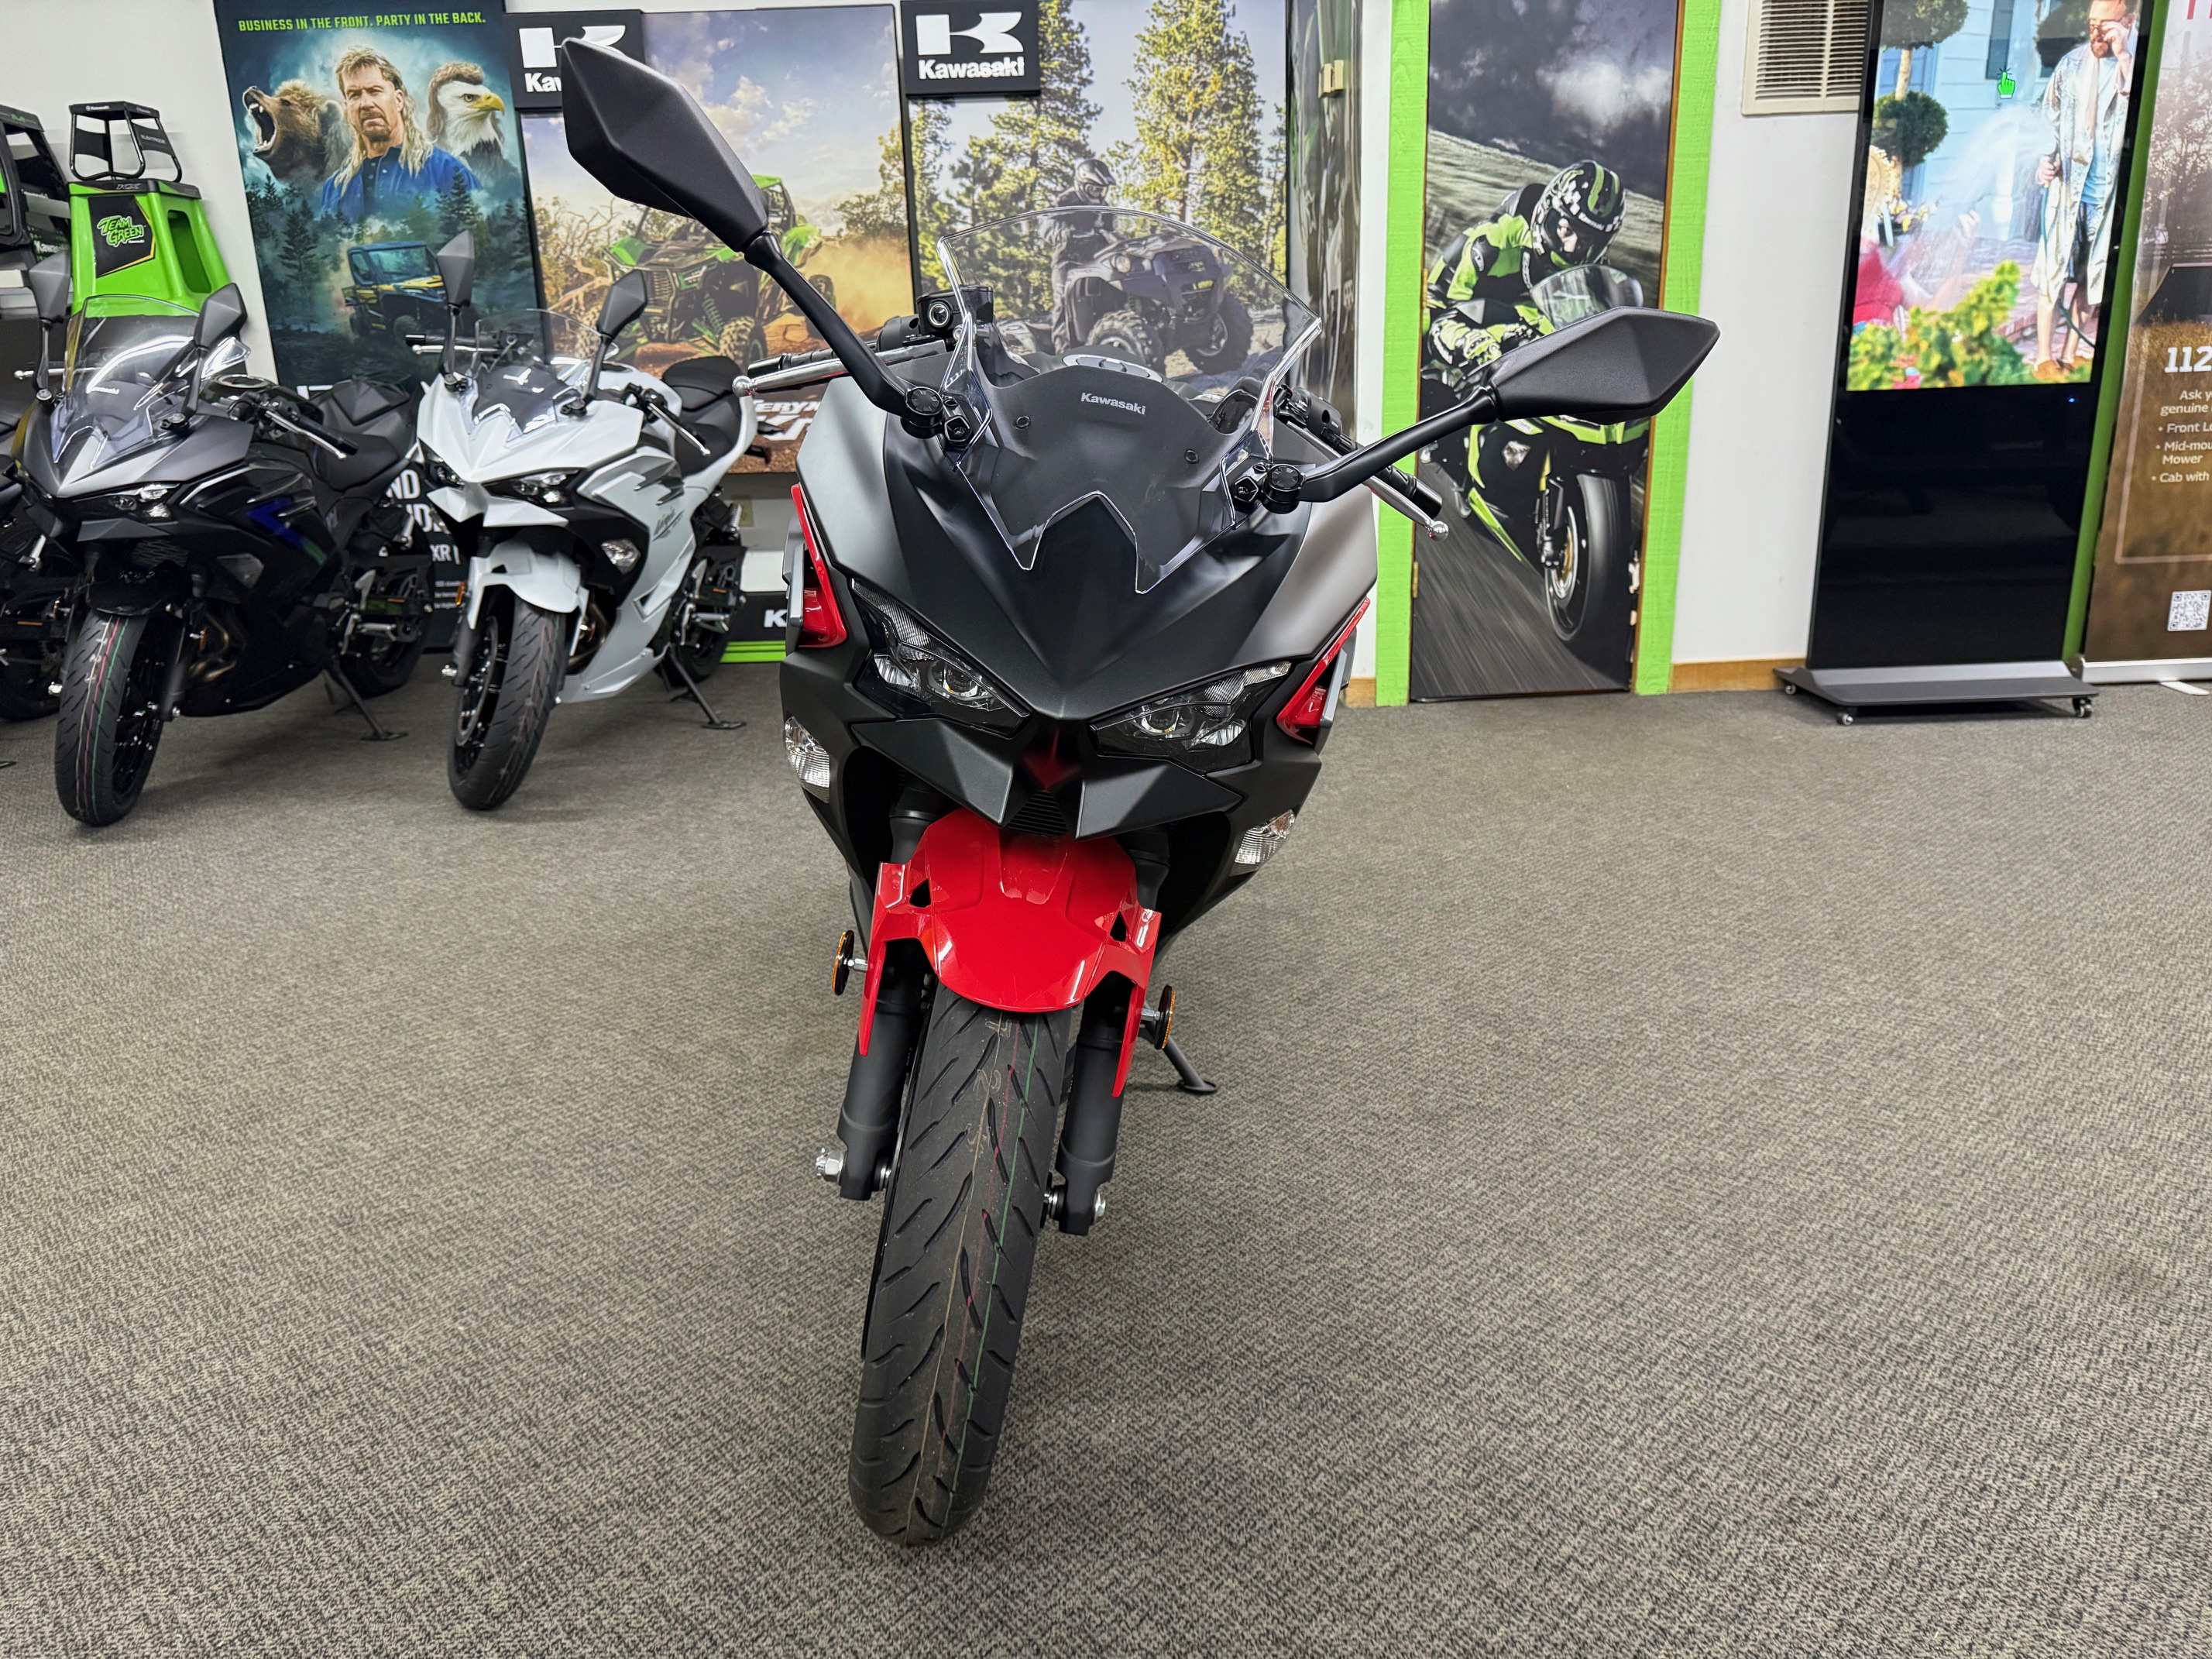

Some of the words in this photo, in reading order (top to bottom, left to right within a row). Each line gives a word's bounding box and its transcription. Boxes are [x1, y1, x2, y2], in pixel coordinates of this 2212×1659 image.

[239, 19, 294, 32] BUSINESS
[295, 18, 308, 30] IN
[310, 17, 332, 29] THE
[334, 15, 373, 28] FRONT.
[376, 14, 411, 26] PARTY
[414, 13, 426, 25] IN
[428, 12, 450, 24] THE
[452, 12, 486, 24] BACK.
[918, 56, 1025, 80] Kawasaki
[97, 215, 132, 235] TEAM
[107, 225, 144, 247] GREEN
[1080, 392, 1146, 415] Kawasaki
[2179, 390, 2202, 400] Ask
[2159, 403, 2208, 417] genuine
[2166, 423, 2200, 433] Front
[2162, 455, 2203, 465] Mower
[2159, 472, 2183, 483] Cab
[2186, 471, 2210, 482] with
